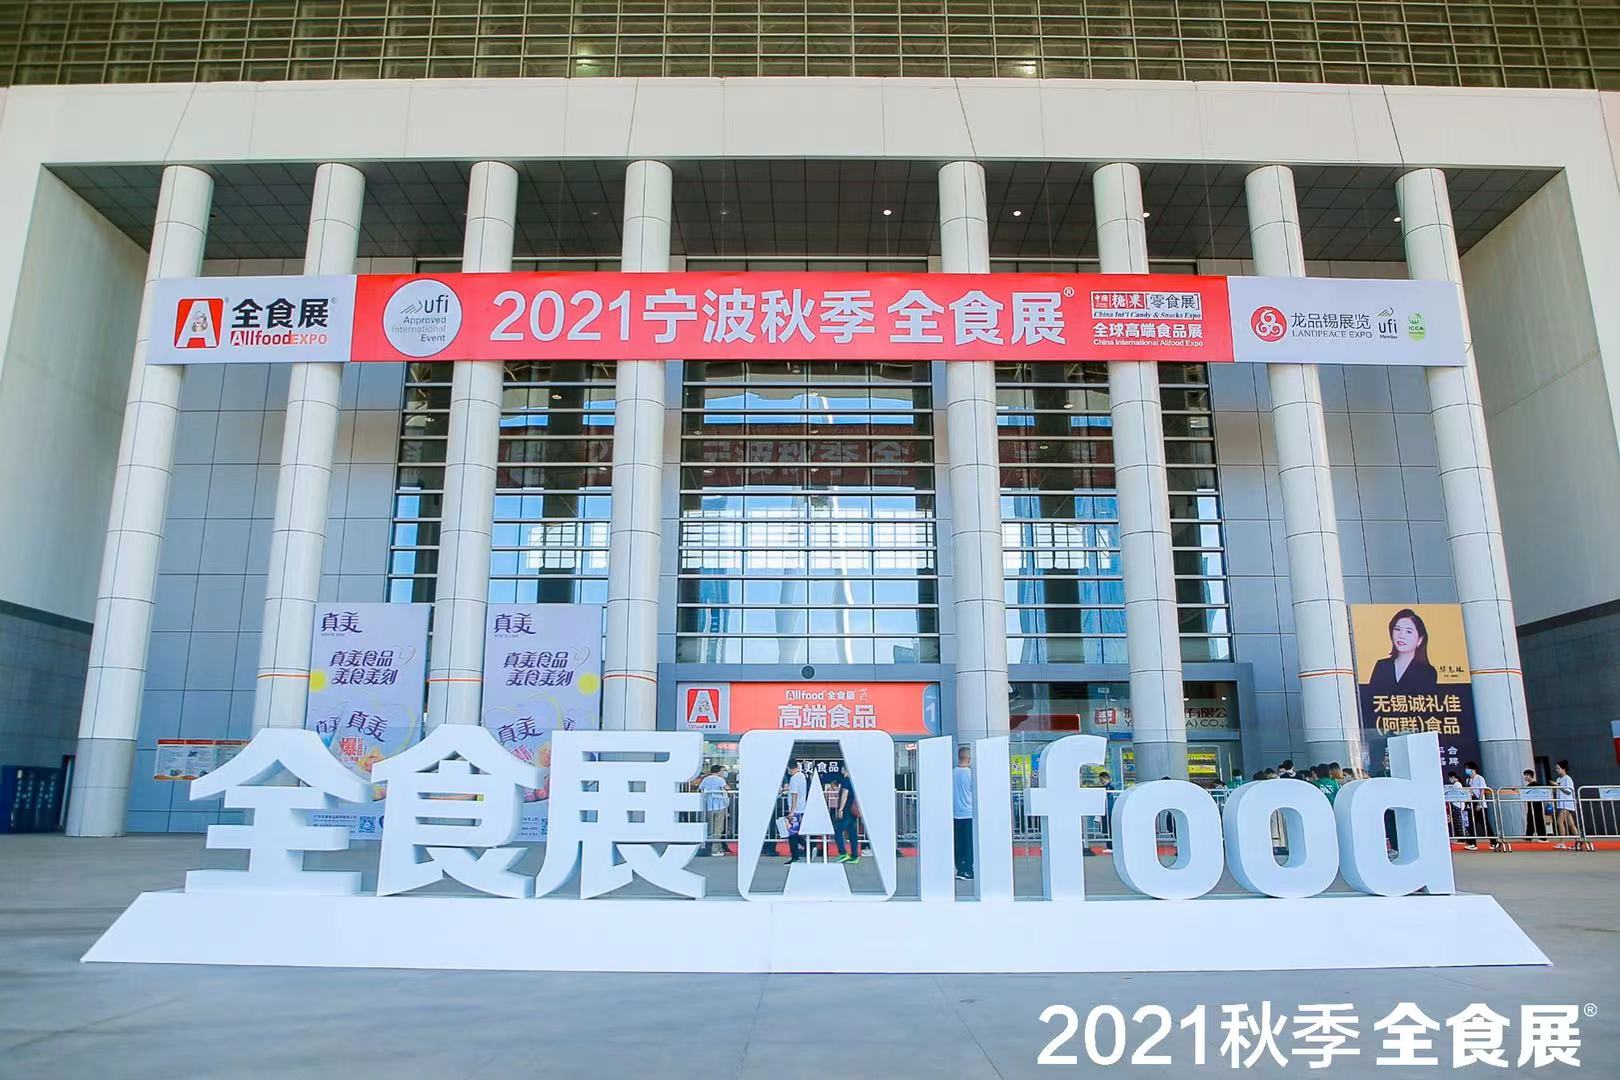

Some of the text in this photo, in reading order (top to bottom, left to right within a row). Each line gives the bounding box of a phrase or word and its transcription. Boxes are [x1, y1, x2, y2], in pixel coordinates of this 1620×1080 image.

[424, 295, 448, 314] ufi
[403, 316, 447, 325] Approved
[1131, 311, 1151, 319] Candy
[1185, 312, 1201, 320] Expo
[1291, 313, 1371, 329] 龙品锡展览
[391, 325, 447, 334] International
[1093, 322, 1203, 338] 全球高端食品展
[1292, 330, 1373, 339] LANDPEACE EXPO
[1378, 319, 1397, 334] ufi
[421, 333, 446, 342] Event
[329, 649, 394, 667] 真美食品
[503, 651, 568, 668] 真美食品
[926, 702, 935, 722] 1
[1373, 695, 1462, 713] 无锡诚礼佳
[777, 703, 877, 729] 高端食品
[186, 724, 708, 898] 全食展
